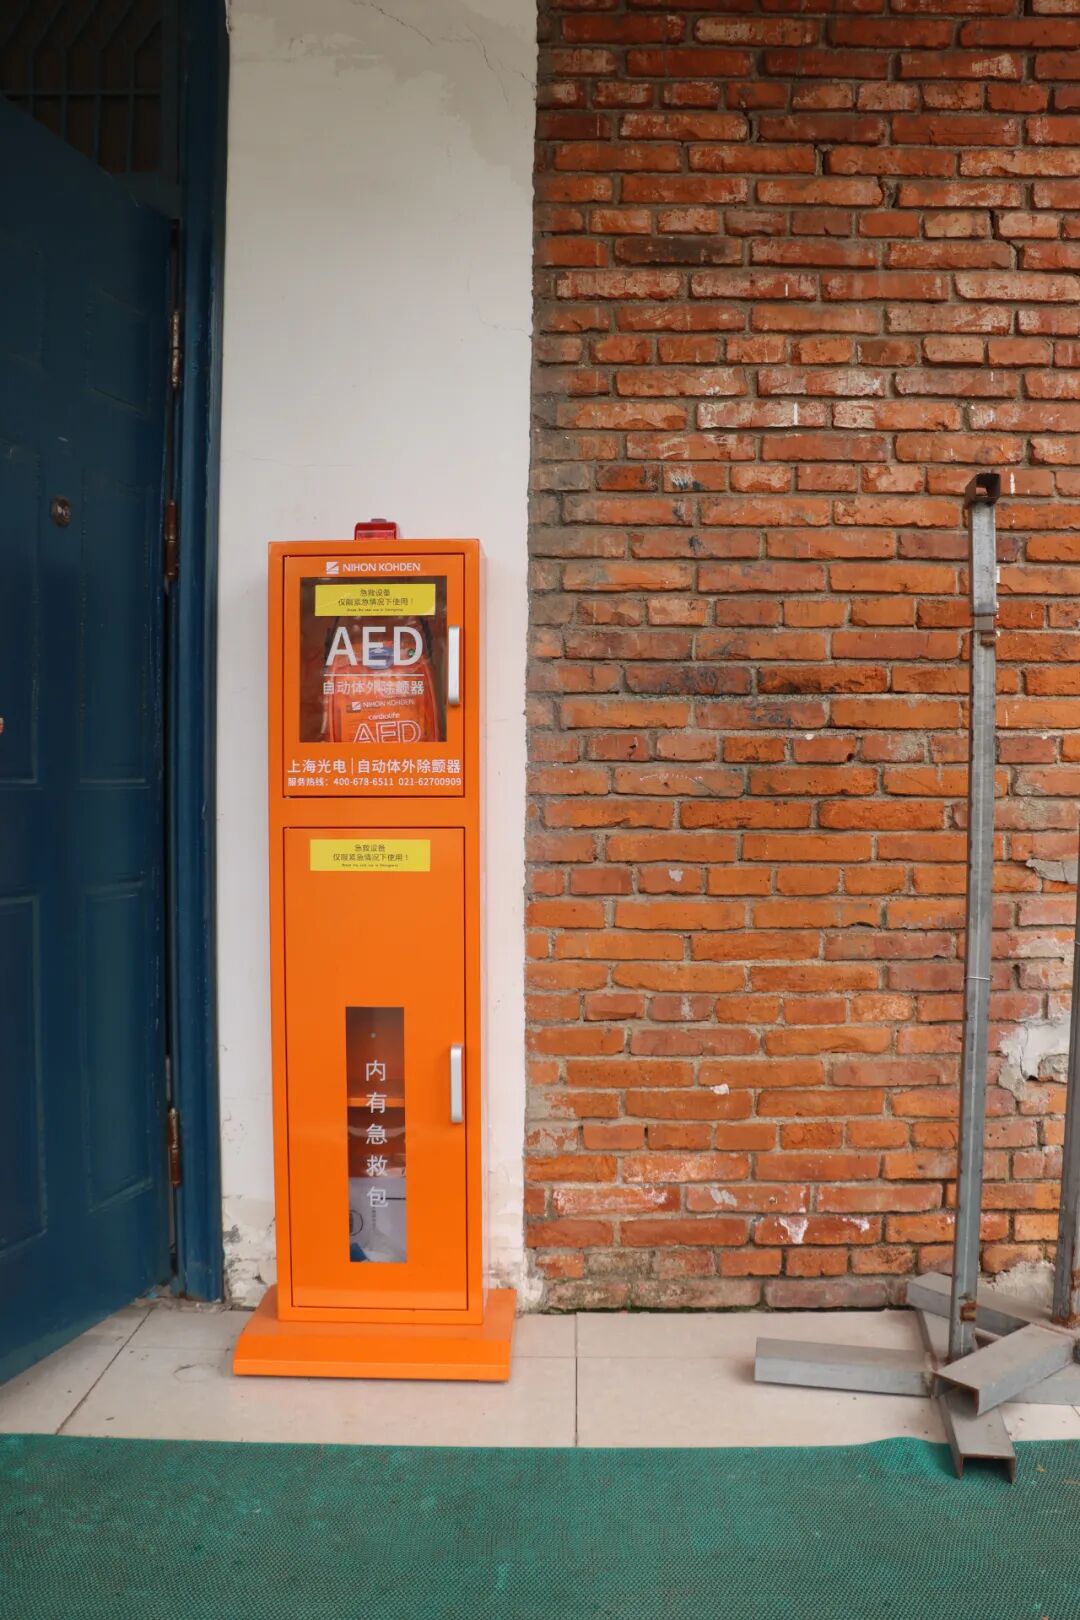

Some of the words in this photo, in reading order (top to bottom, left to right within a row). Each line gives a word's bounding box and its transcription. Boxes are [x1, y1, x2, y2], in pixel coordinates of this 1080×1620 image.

[343, 563, 376, 572] NIHON
[379, 562, 421, 571] KOHDEN
[325, 626, 423, 666] AED
[323, 680, 424, 695] 自动体外除颤器
[363, 701, 386, 709] NIHON
[387, 699, 416, 707] KOHDEN
[353, 720, 422, 743] AED
[287, 759, 347, 774] 上海光电
[358, 759, 461, 774] 自动体外除颤器
[333, 777, 394, 786] 400-678-6511
[398, 777, 462, 786] 021-62700909
[366, 1060, 388, 1207] 内有急救包
